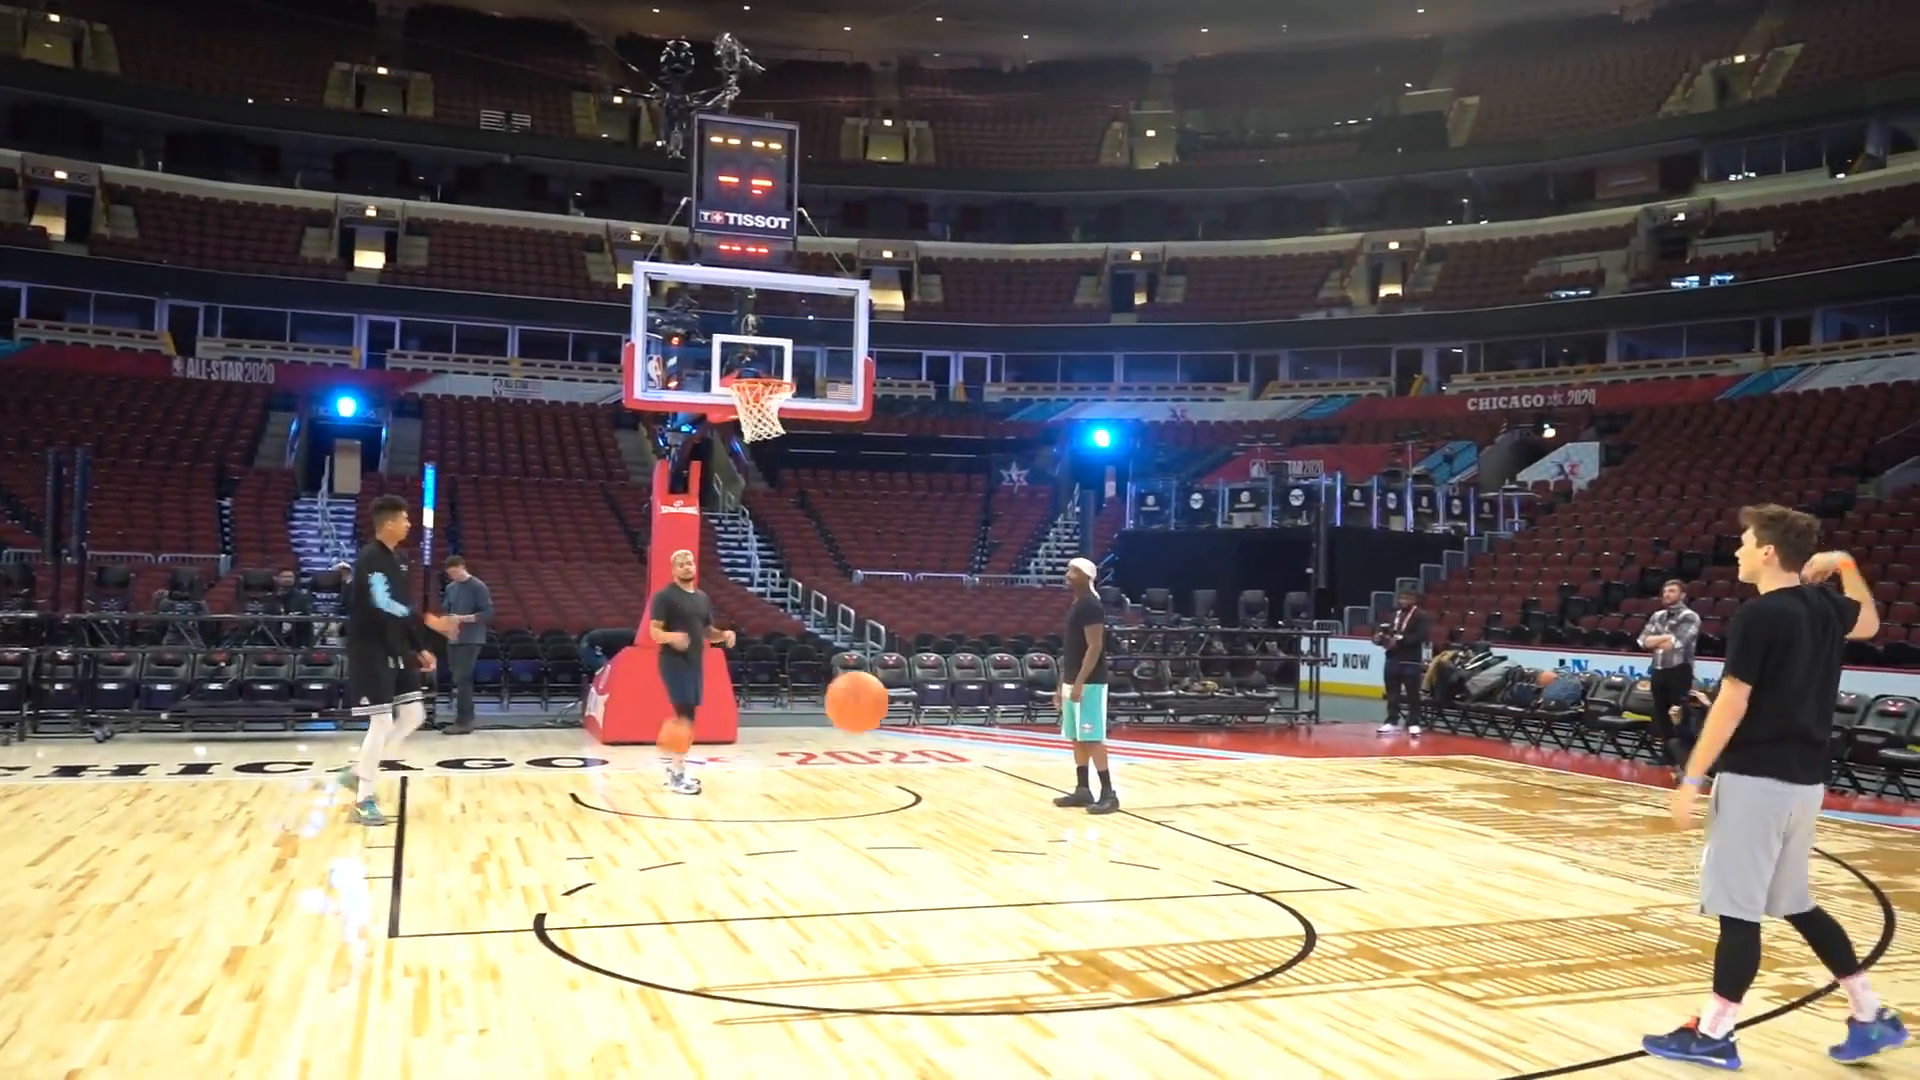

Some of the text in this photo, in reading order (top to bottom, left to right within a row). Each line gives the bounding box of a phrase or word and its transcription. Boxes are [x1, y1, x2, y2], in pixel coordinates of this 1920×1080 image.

[725, 212, 790, 230] TISSOT
[244, 361, 275, 384] 2020
[1467, 388, 1597, 411] CHICAGO 2020
[1342, 653, 1370, 670] NOW
[777, 750, 972, 766] 2020
